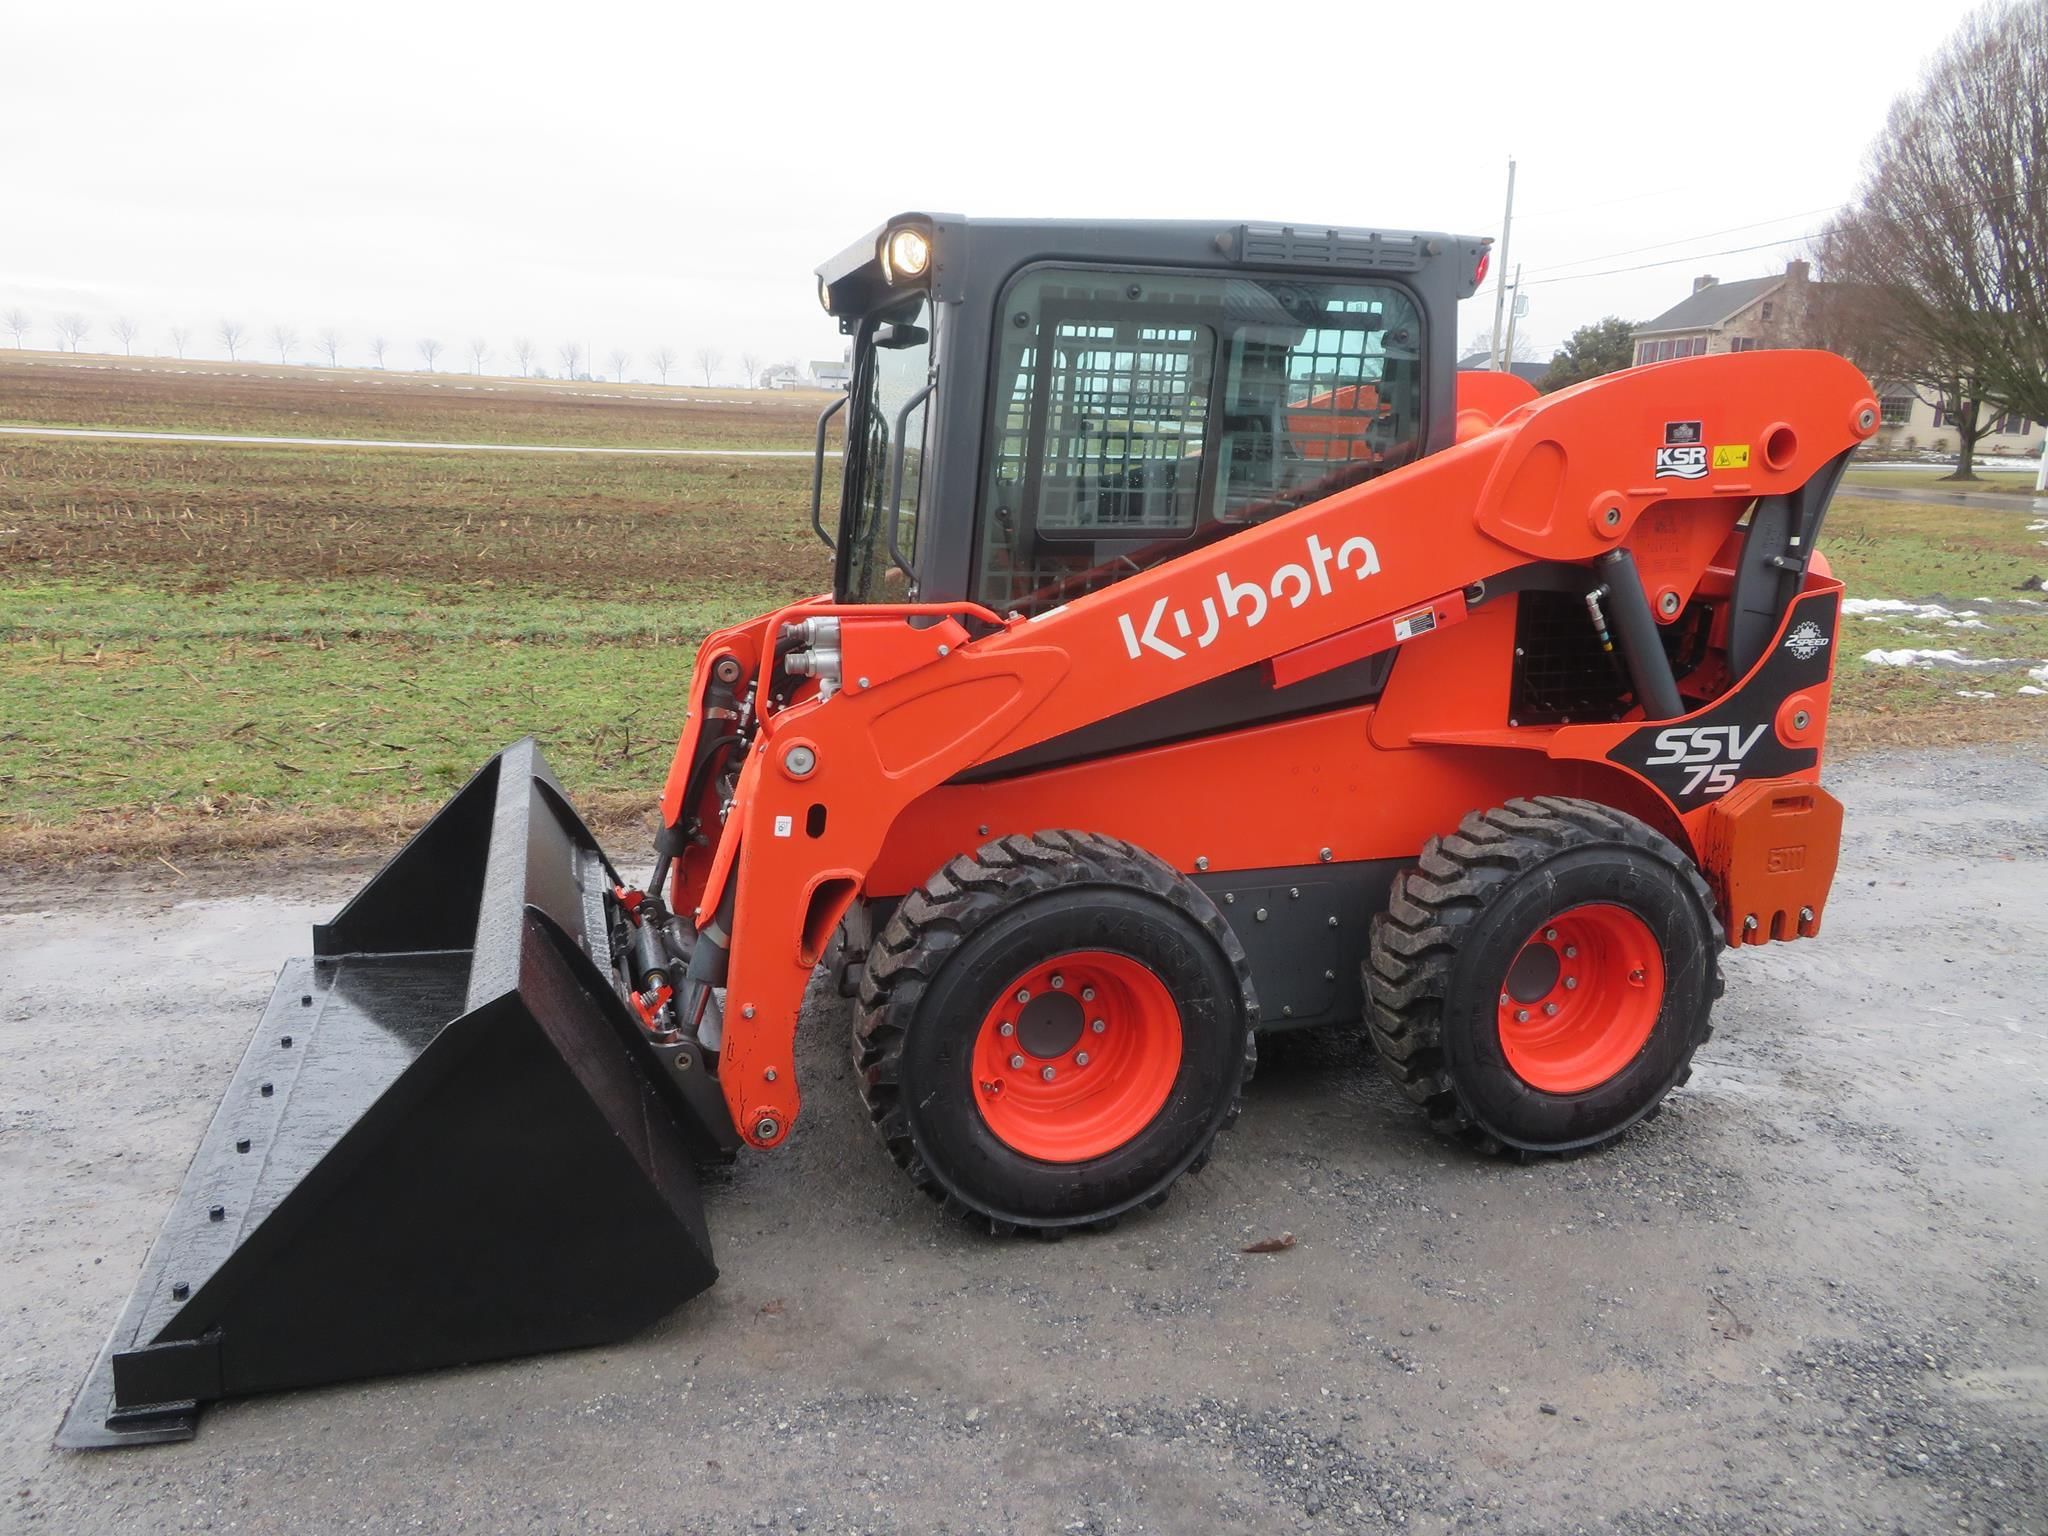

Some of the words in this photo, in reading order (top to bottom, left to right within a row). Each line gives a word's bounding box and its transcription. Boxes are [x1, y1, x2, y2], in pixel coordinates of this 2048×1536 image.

[1657, 447, 1706, 466] KSR
[1118, 534, 1381, 660] Kubota
[1645, 724, 1768, 766] SSV
[1678, 763, 1741, 796] 75
